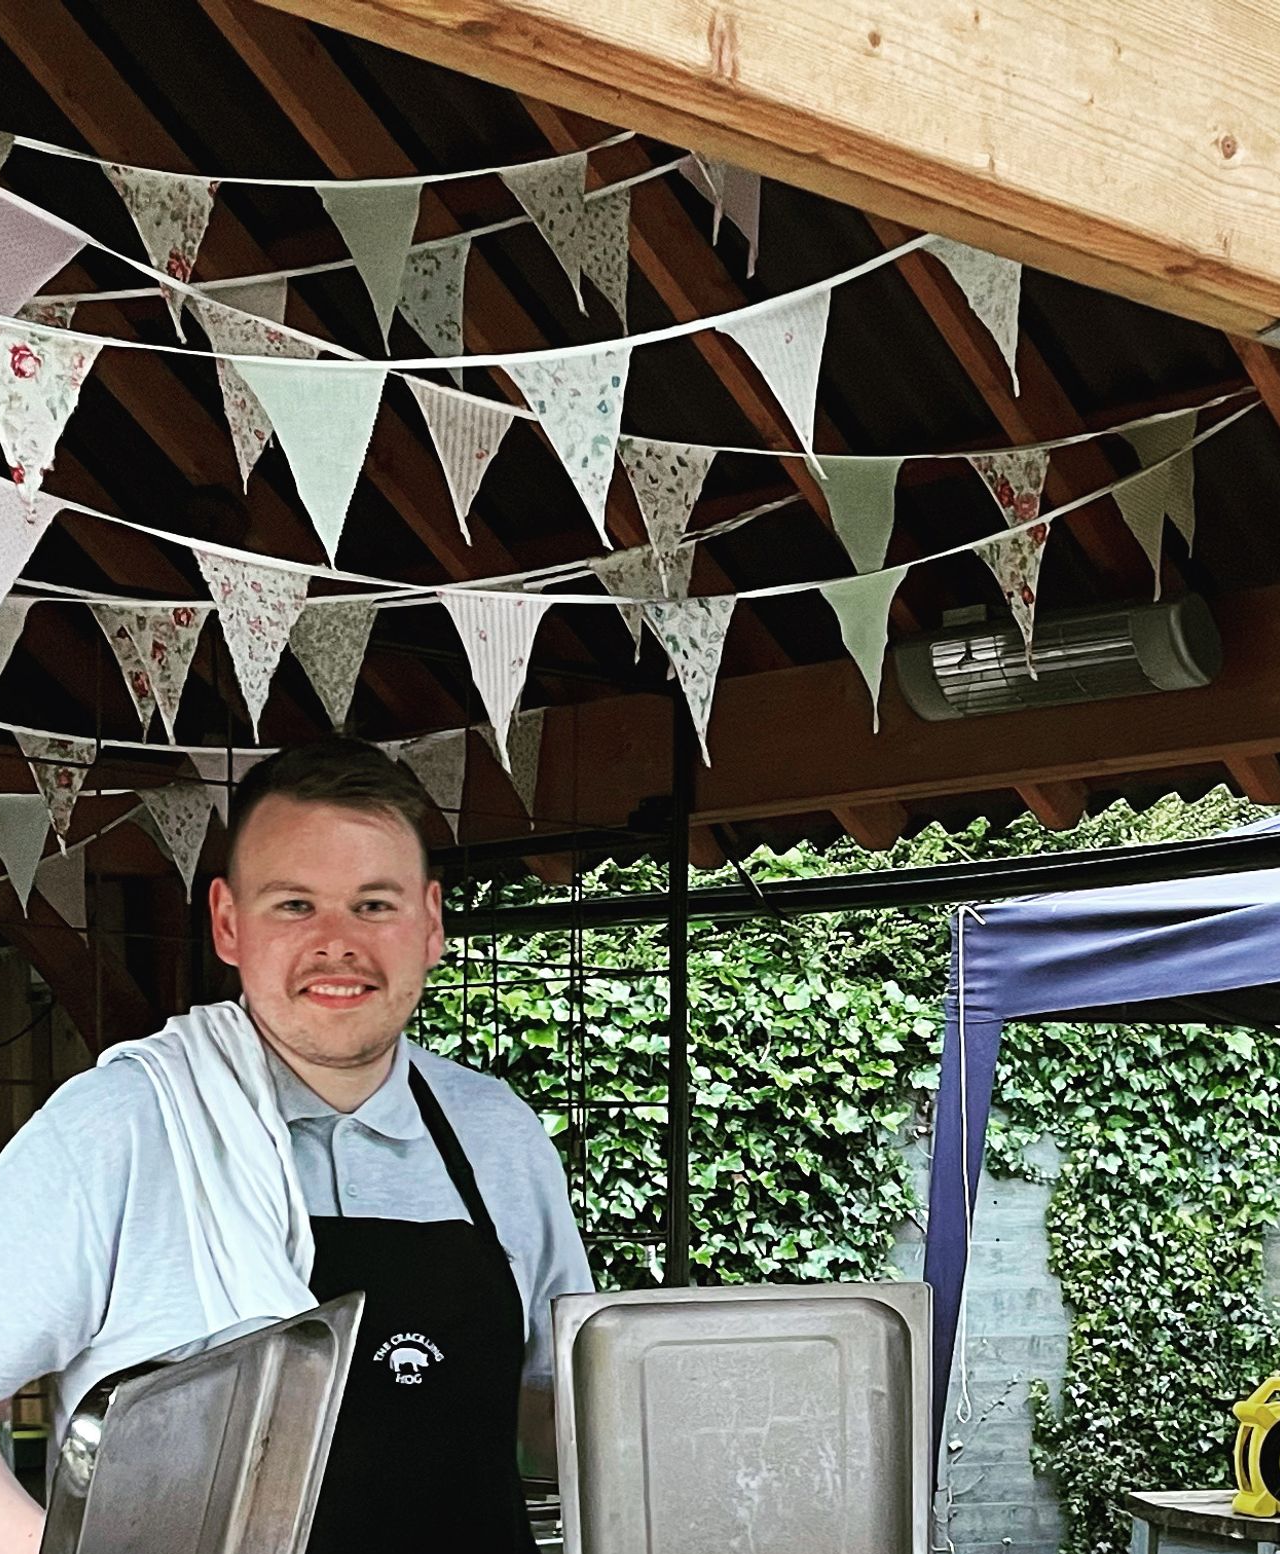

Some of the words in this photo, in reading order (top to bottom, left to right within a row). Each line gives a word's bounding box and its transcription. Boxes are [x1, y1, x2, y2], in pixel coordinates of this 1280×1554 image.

[373, 1341, 392, 1361] THE
[390, 1332, 445, 1362] CRACKLING
[395, 1373, 423, 1384] HOG
